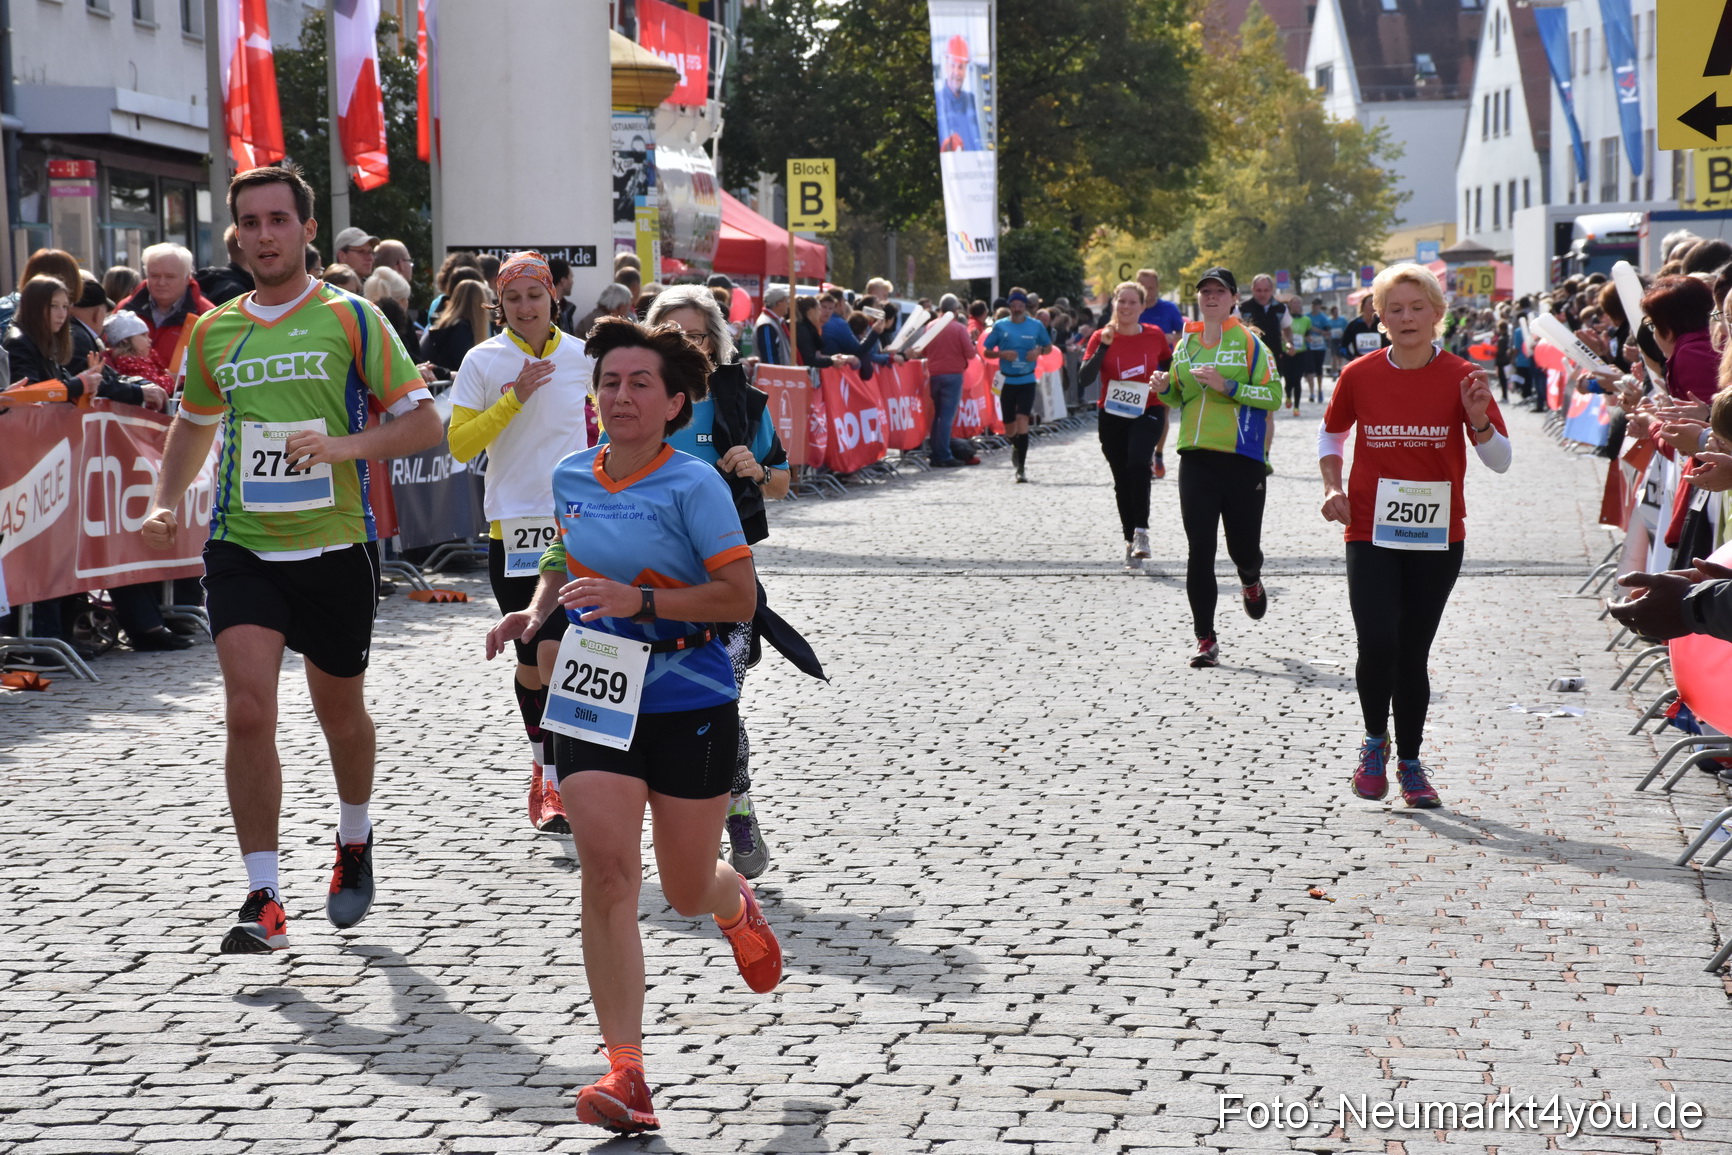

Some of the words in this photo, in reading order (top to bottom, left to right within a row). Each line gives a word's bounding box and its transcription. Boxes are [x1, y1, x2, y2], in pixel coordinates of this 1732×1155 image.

[66, 161, 79, 177] T
[793, 162, 829, 175] Block
[1708, 157, 1732, 193] B
[800, 181, 823, 215] B
[1119, 263, 1132, 281] C
[1185, 282, 1195, 297] D
[1481, 274, 1492, 289] D
[1360, 339, 1378, 347] 2148
[214, 352, 330, 392] BOCK
[1112, 388, 1142, 405] 2328
[1403, 439, 1428, 448] KÜCHE
[391, 453, 452, 486] RAIL.ONE
[33, 458, 65, 524] NEUE
[583, 510, 619, 520] Neumarkt
[646, 513, 659, 522] eG
[1386, 500, 1441, 524] 2507
[513, 526, 556, 549] 279
[1394, 529, 1429, 539] Michaela
[587, 639, 619, 657] BOCK
[561, 659, 629, 705] 2259
[574, 706, 599, 724] Stilla
